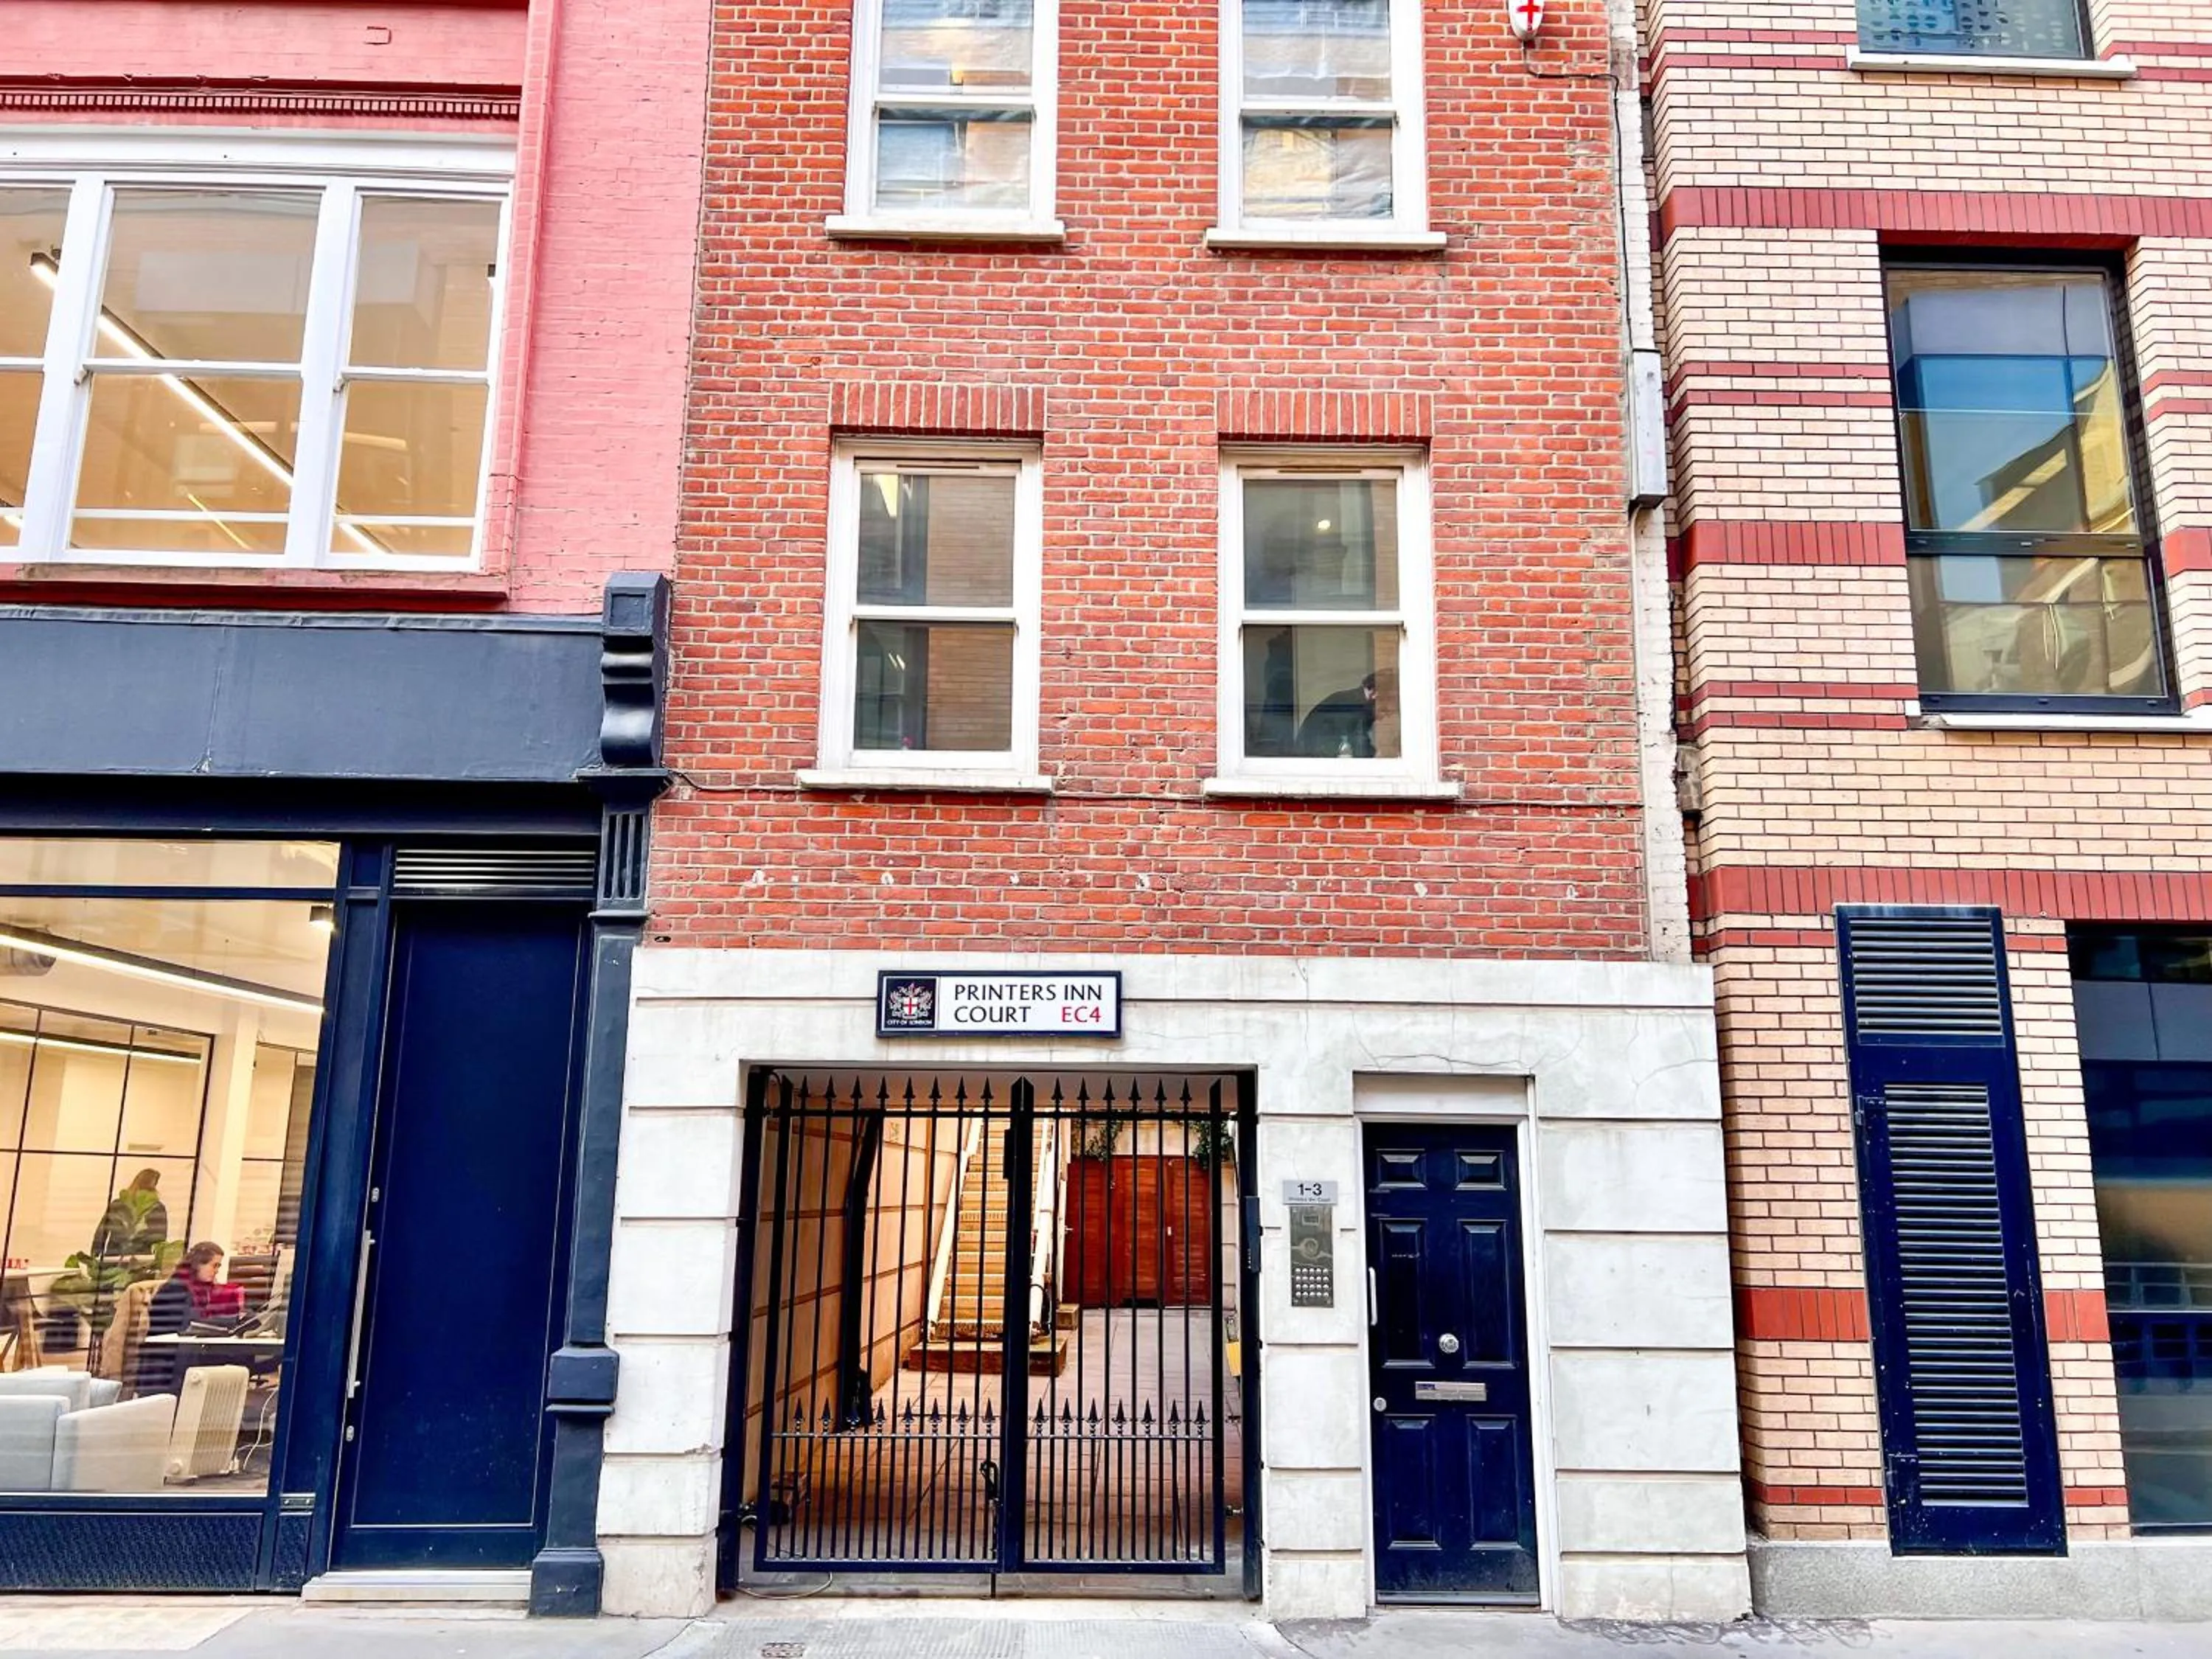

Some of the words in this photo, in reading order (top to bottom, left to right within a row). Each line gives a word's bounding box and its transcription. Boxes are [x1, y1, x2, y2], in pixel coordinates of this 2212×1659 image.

[954, 984, 1057, 1001] PRINTERS
[1064, 984, 1102, 1001] INN
[954, 1006, 1032, 1023] COURT
[1062, 1006, 1102, 1023] EC4
[1298, 1183, 1322, 1196] 1-3
